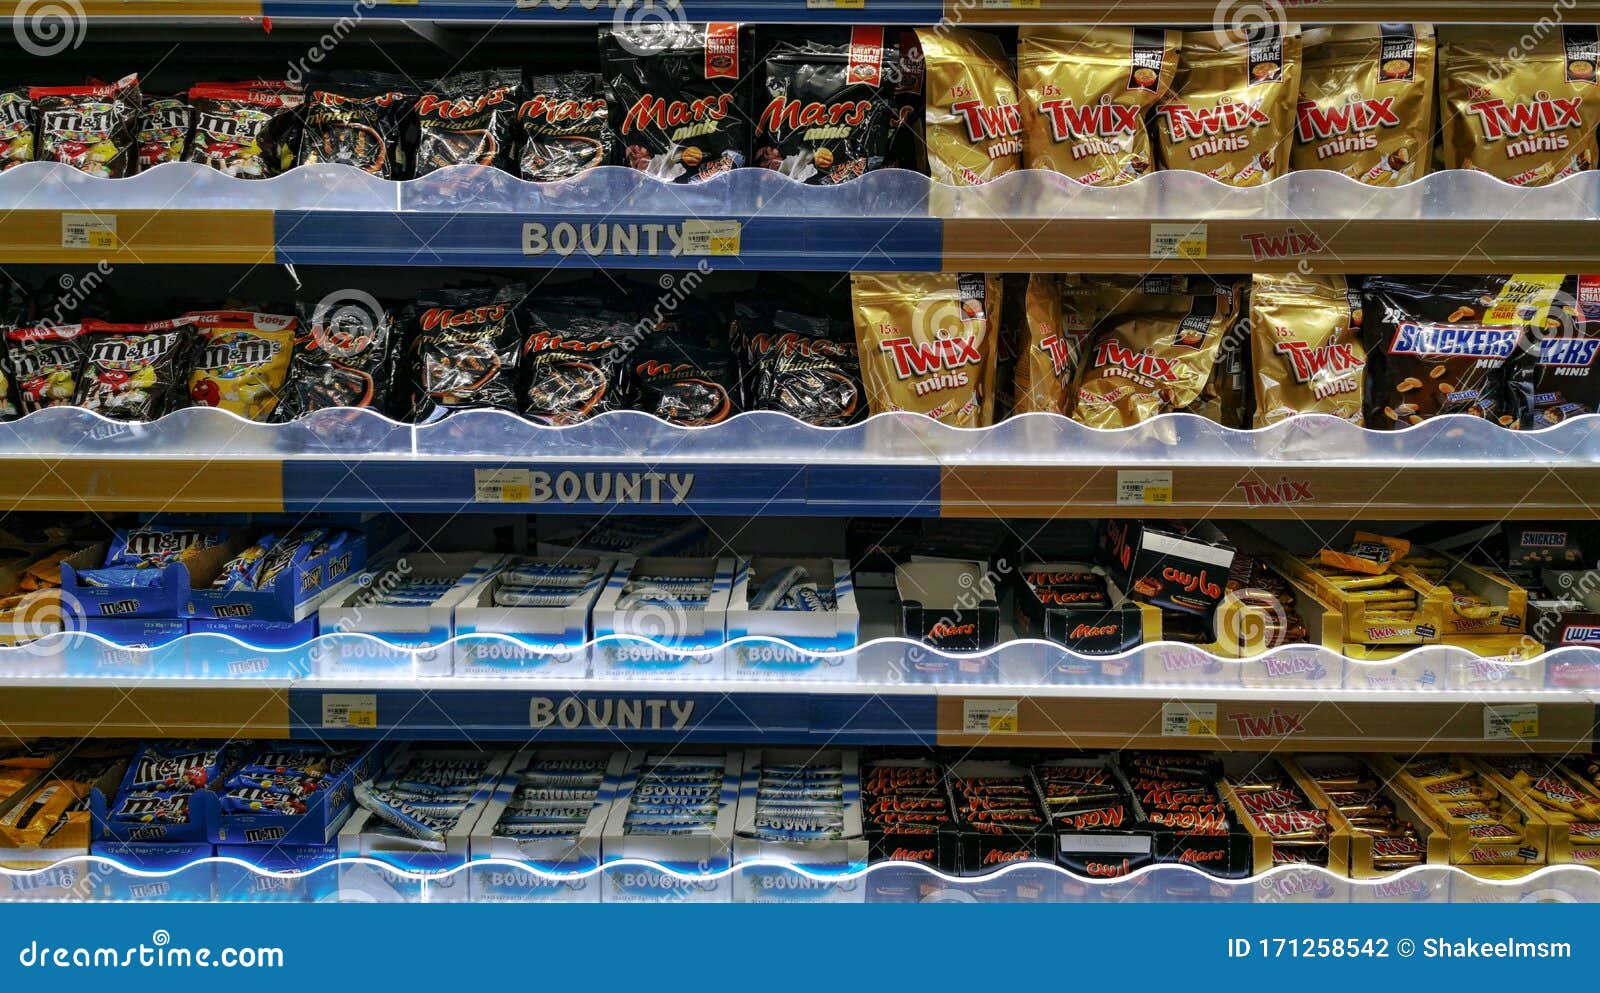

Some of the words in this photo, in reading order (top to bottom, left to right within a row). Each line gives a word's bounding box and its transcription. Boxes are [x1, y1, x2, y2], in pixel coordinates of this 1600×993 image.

[708, 45, 736, 54] SHARE
[851, 54, 880, 64] SHARE
[1251, 52, 1282, 62] SHARE
[1382, 50, 1414, 59] SHARE
[1567, 52, 1597, 60] SHARE
[1134, 60, 1162, 69] SHARE
[414, 86, 516, 118] Mars
[950, 86, 972, 98] 15x
[1041, 85, 1061, 97] 15x
[1466, 87, 1491, 99] 15x
[517, 95, 608, 122] Mar
[622, 94, 734, 135] Mars
[755, 96, 872, 136] Mars
[1039, 94, 1140, 142] Twix
[1157, 95, 1270, 142] Twix
[1296, 93, 1400, 142] Twix
[1467, 90, 1583, 142] Twix
[672, 119, 719, 141] minis
[803, 125, 852, 141] minis
[1189, 132, 1250, 160] minis
[1317, 133, 1379, 159] minis
[1506, 132, 1570, 158] minis
[522, 222, 685, 258] BOUNTY
[1241, 227, 1322, 262] Twix
[961, 289, 986, 300] SHARE
[258, 315, 287, 326] 300g
[419, 303, 508, 331] Mars
[1182, 318, 1209, 331] SHARE
[879, 323, 900, 335] 15x
[1275, 326, 1296, 338] 15x
[1393, 324, 1517, 357] SNICKERS
[880, 328, 982, 380] Twix
[1094, 338, 1180, 382] Twix
[1276, 333, 1367, 384] Twix
[1536, 338, 1600, 365] KERS
[1103, 366, 1156, 388] minis
[1554, 367, 1590, 376] MINIS
[914, 370, 970, 398] minis
[1312, 377, 1358, 401] minis
[531, 470, 695, 504] BOUNTY
[1236, 476, 1314, 508] Twix
[1522, 532, 1566, 546] SNICKERS
[927, 622, 975, 638] Mars
[1070, 623, 1118, 640] Mars
[1367, 626, 1397, 640] Twix
[529, 696, 695, 731] BOUNTY
[1229, 708, 1305, 740] Twix
[641, 785, 715, 796] BOUNTY
[1251, 808, 1326, 837] Twix
[889, 847, 935, 861] Mars
[983, 848, 1031, 864] Mars
[1178, 848, 1225, 864] Mars
